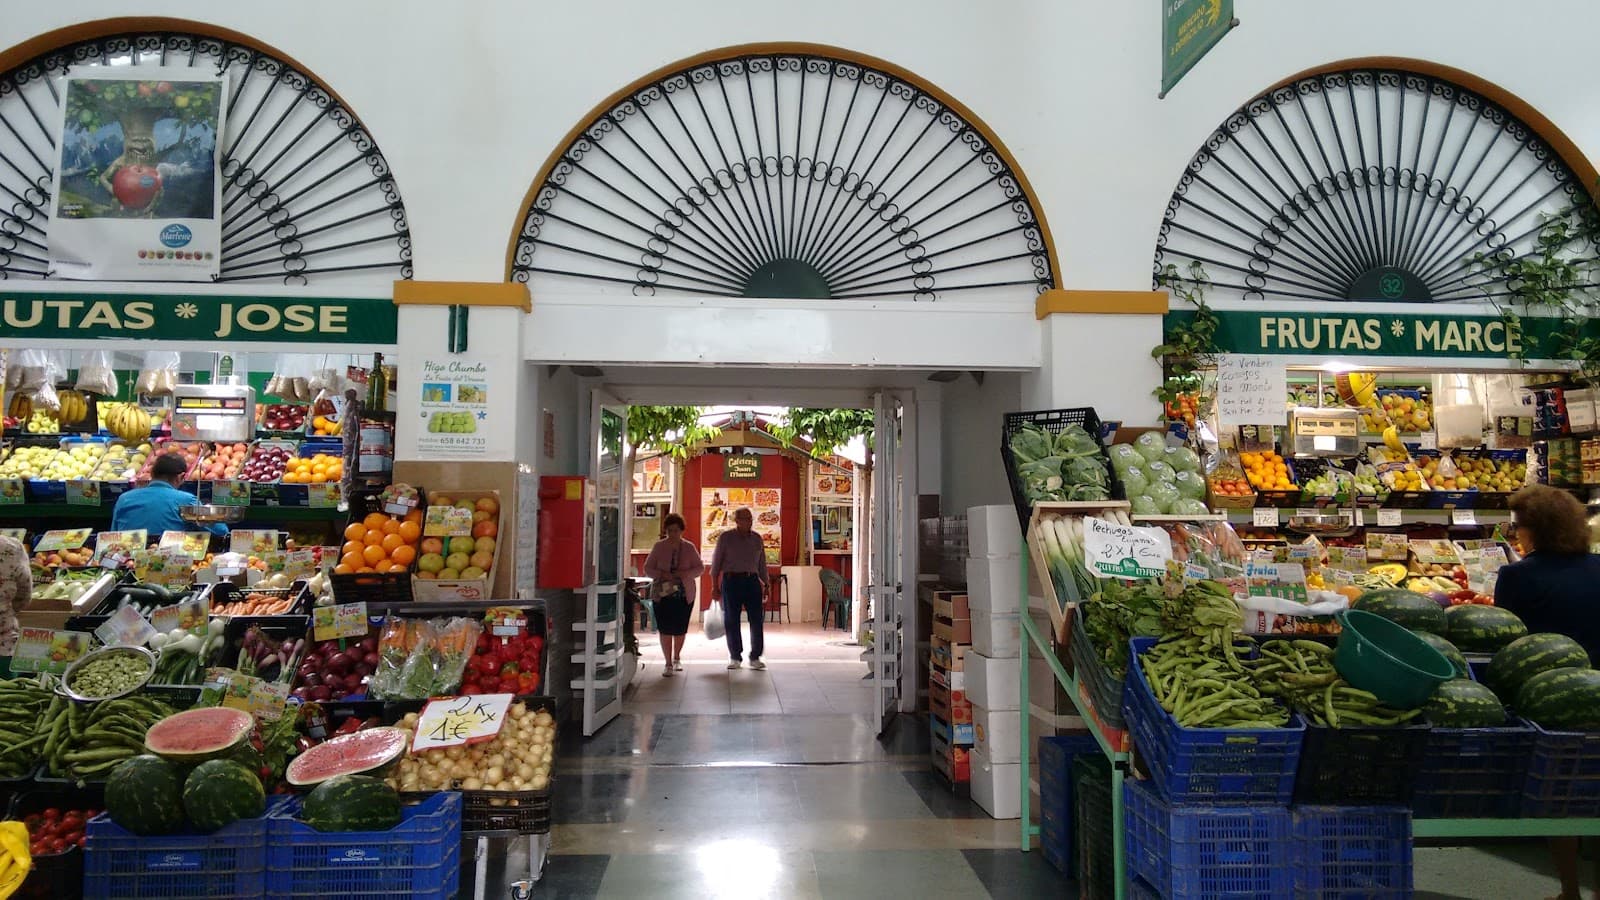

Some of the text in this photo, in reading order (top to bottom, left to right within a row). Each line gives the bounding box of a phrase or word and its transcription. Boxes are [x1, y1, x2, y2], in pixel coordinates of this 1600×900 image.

[1383, 278, 1401, 293] 32
[0, 299, 348, 337] UTAS JOSE
[1260, 317, 1522, 352] FRUTAS MARCE
[424, 360, 487, 374] Higo Chumbo
[440, 437, 454, 445] 658
[456, 437, 470, 445] 642
[1246, 562, 1278, 577] Frutas
